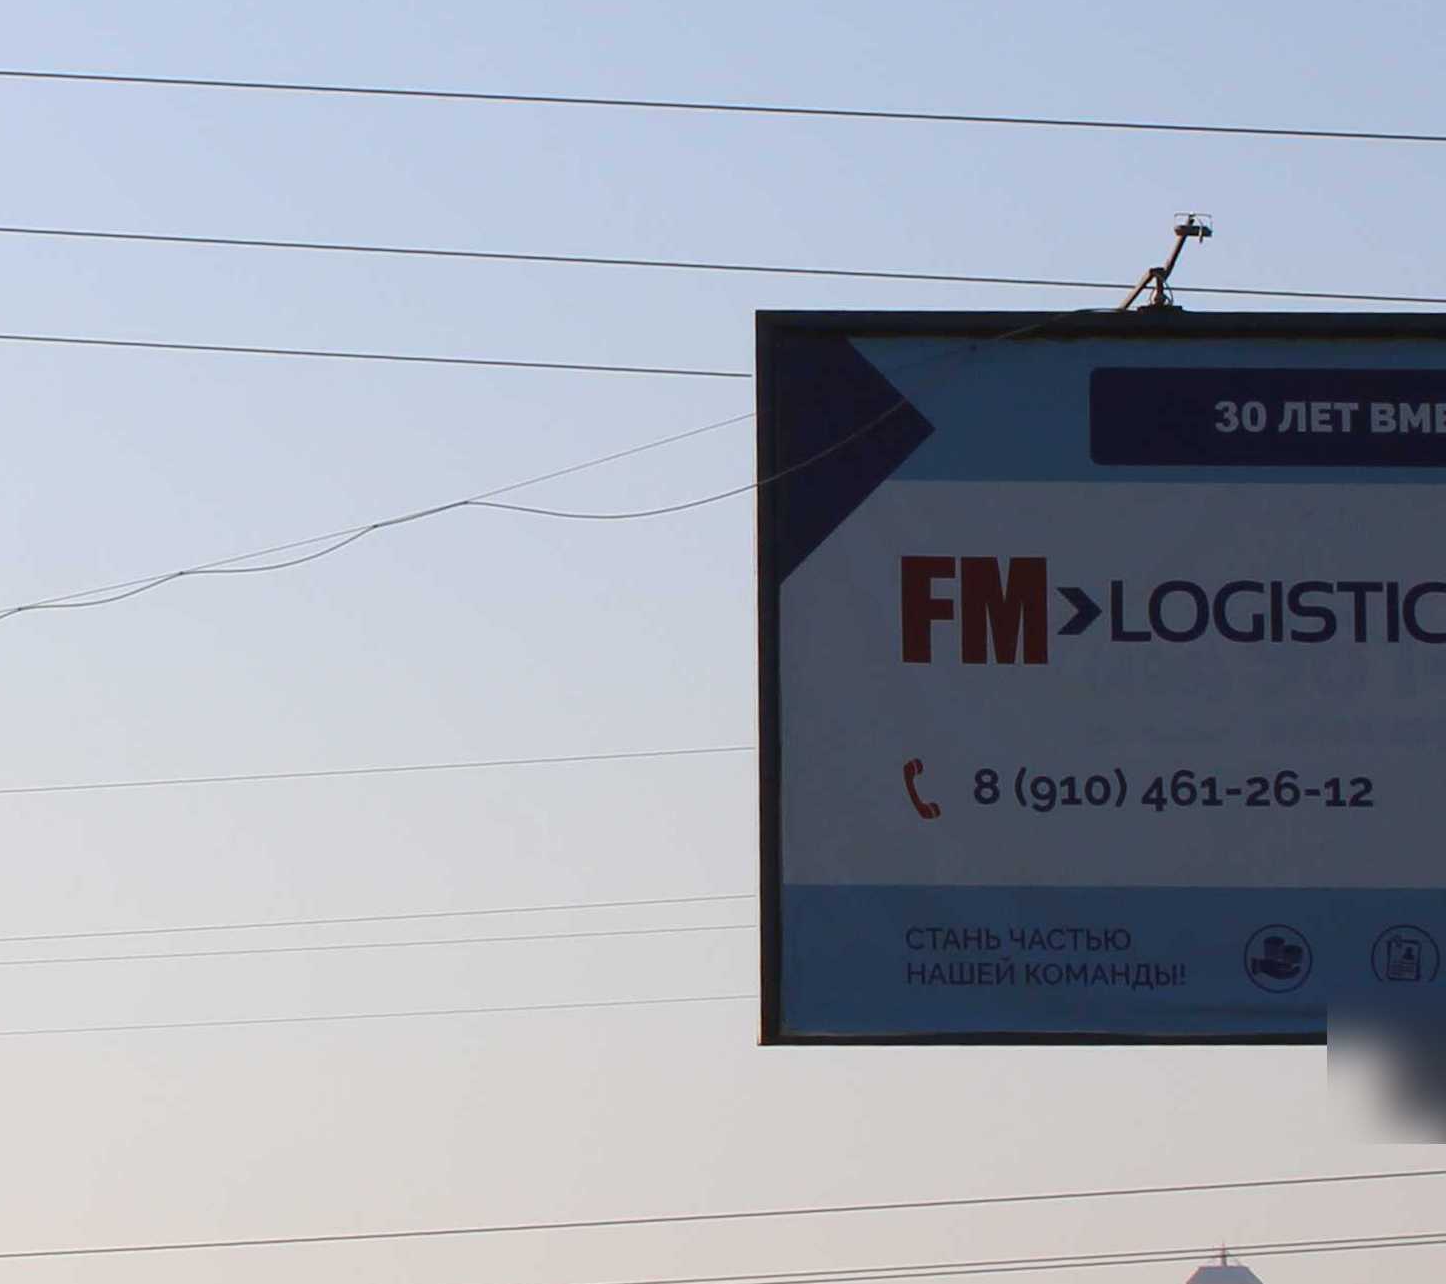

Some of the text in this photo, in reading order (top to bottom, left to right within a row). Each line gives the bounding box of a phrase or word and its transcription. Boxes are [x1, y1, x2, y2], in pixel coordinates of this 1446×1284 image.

[1214, 401, 1267, 433] 30
[1278, 402, 1359, 433] ЛЕТ
[900, 556, 1049, 665] FM
[973, 766, 1375, 813] 8 (910) 461-26-12
[905, 927, 1131, 952] СТАНЬ ЧАСТЬЮ
[906, 956, 1187, 990] НАШЕЙ КОМАНДЫ!
